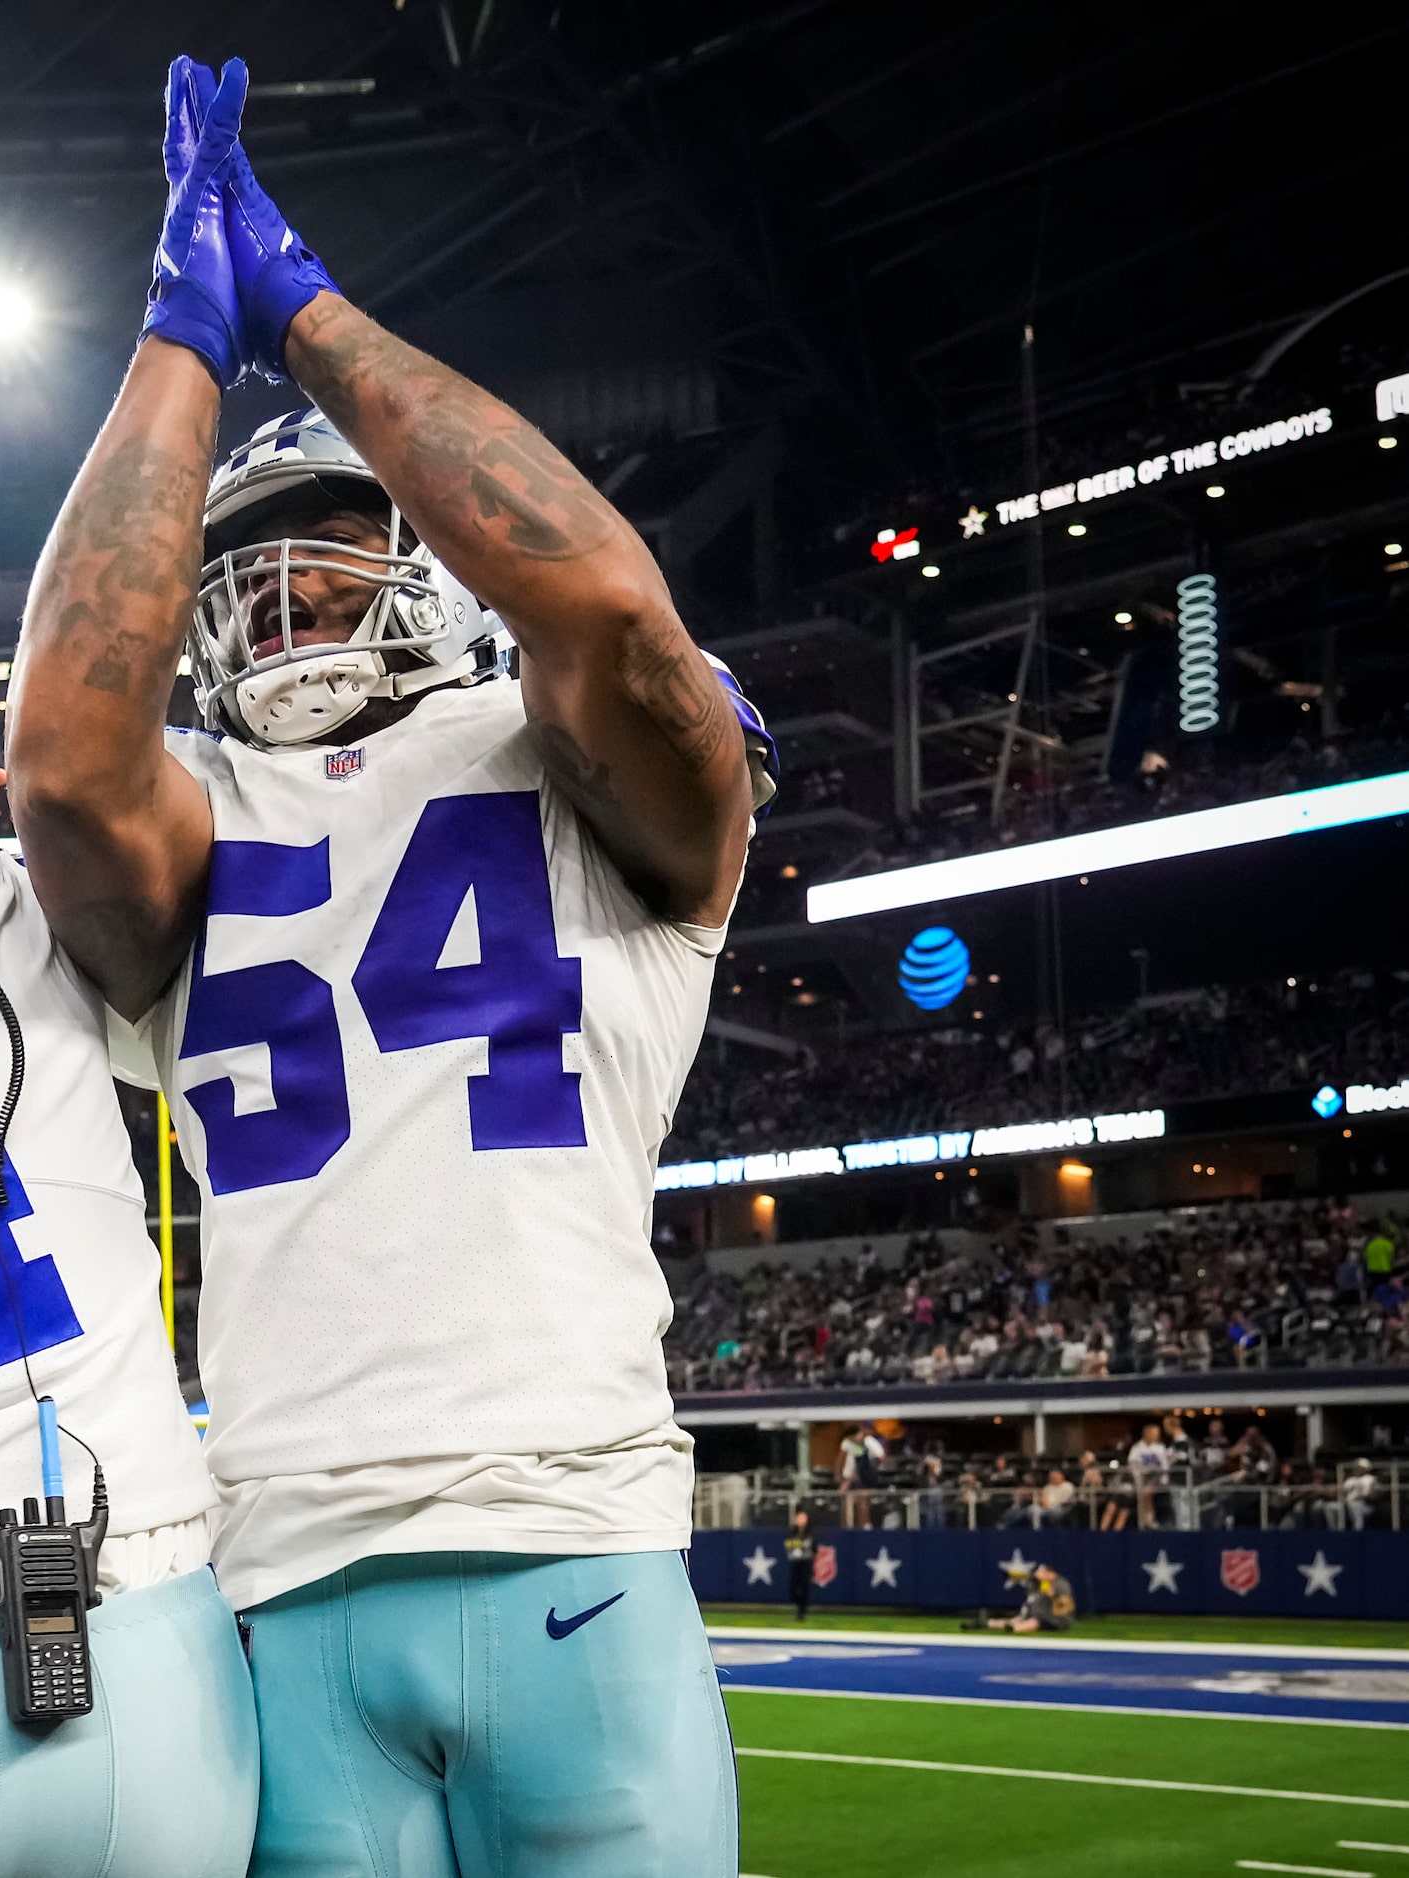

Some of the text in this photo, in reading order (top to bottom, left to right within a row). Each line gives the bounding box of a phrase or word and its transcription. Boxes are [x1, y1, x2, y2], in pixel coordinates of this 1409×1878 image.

[995, 493, 1039, 525] THE
[1077, 465, 1136, 503] BEER
[1137, 455, 1169, 485] OF
[1170, 440, 1218, 475] THE
[1219, 407, 1333, 461] COWBOYS
[330, 757, 359, 774] NFL
[178, 789, 588, 1197] 54
